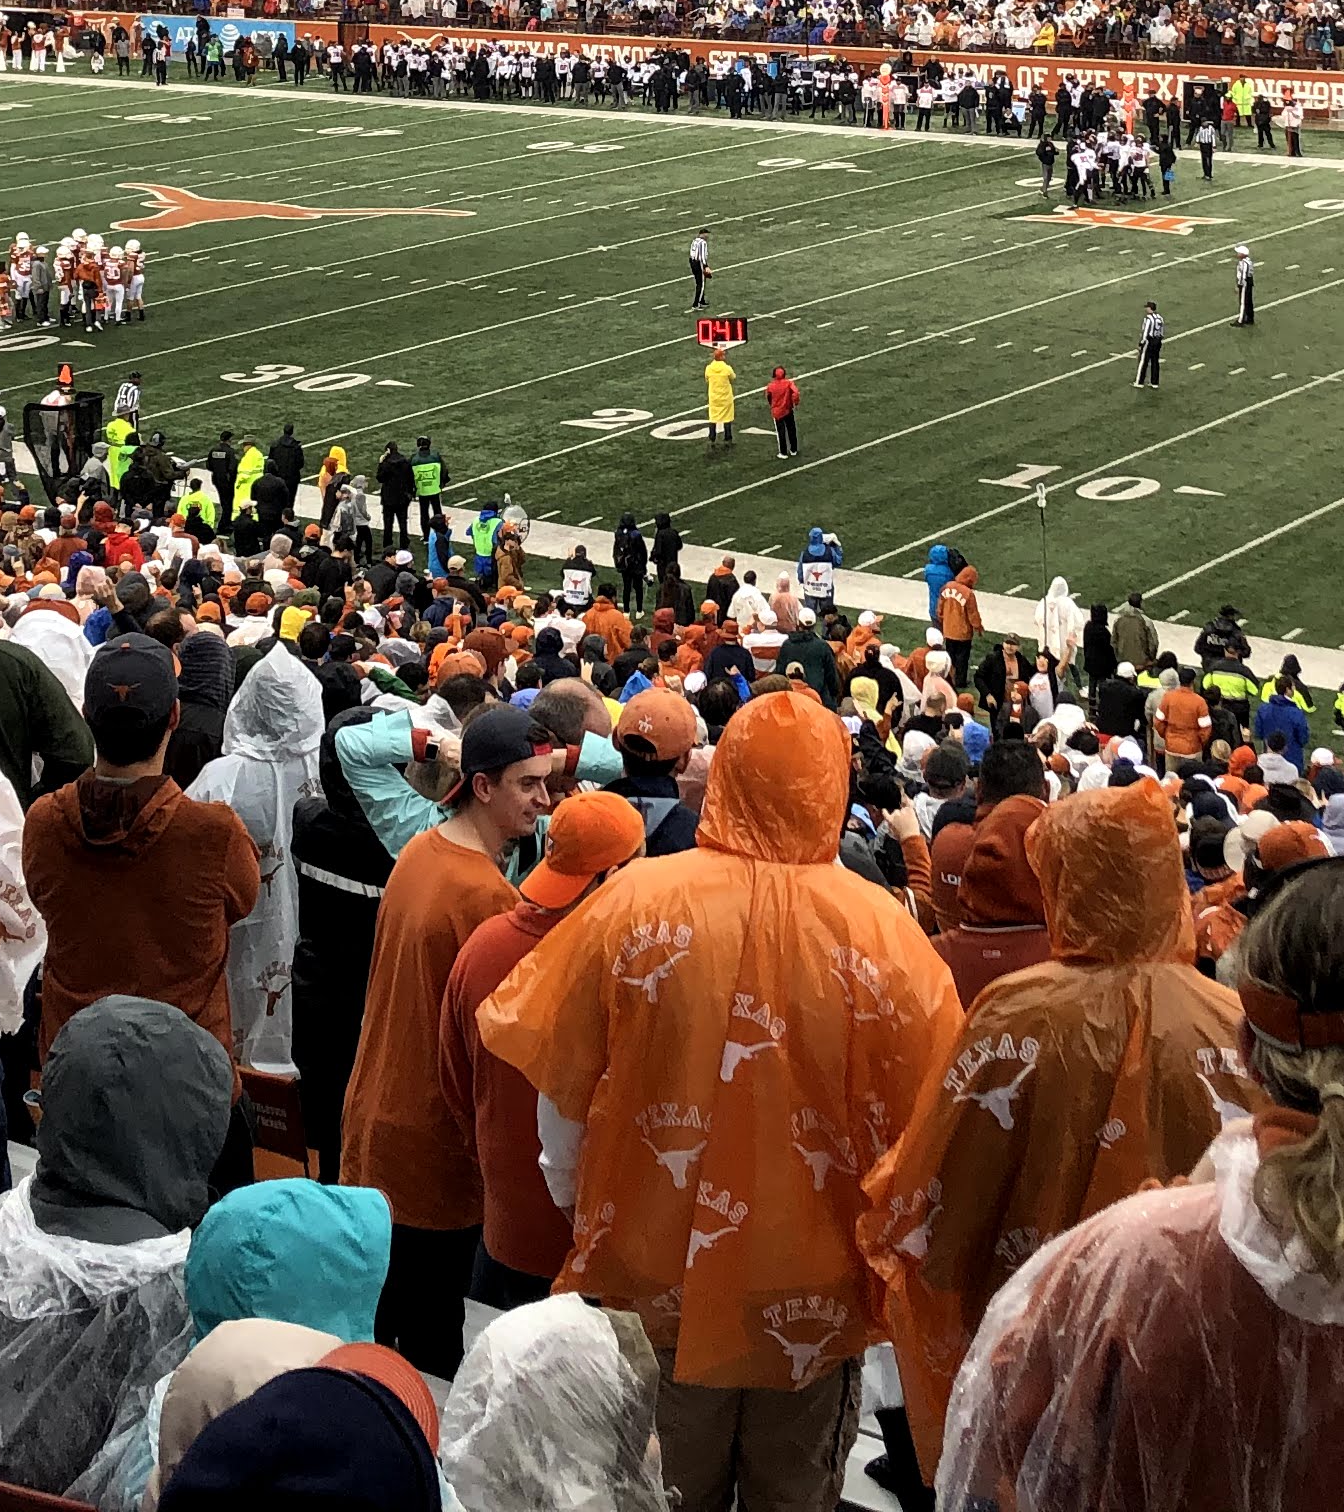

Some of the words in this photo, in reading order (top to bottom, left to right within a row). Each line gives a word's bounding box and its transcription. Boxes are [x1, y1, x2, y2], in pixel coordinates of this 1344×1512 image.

[219, 364, 372, 392] 30
[560, 408, 726, 441] 20
[978, 462, 1161, 501] 10
[612, 919, 693, 976] TEXAS
[731, 992, 787, 1041] XAS
[943, 1032, 1042, 1095] TEXAS
[763, 1294, 849, 1330] TEXAS
